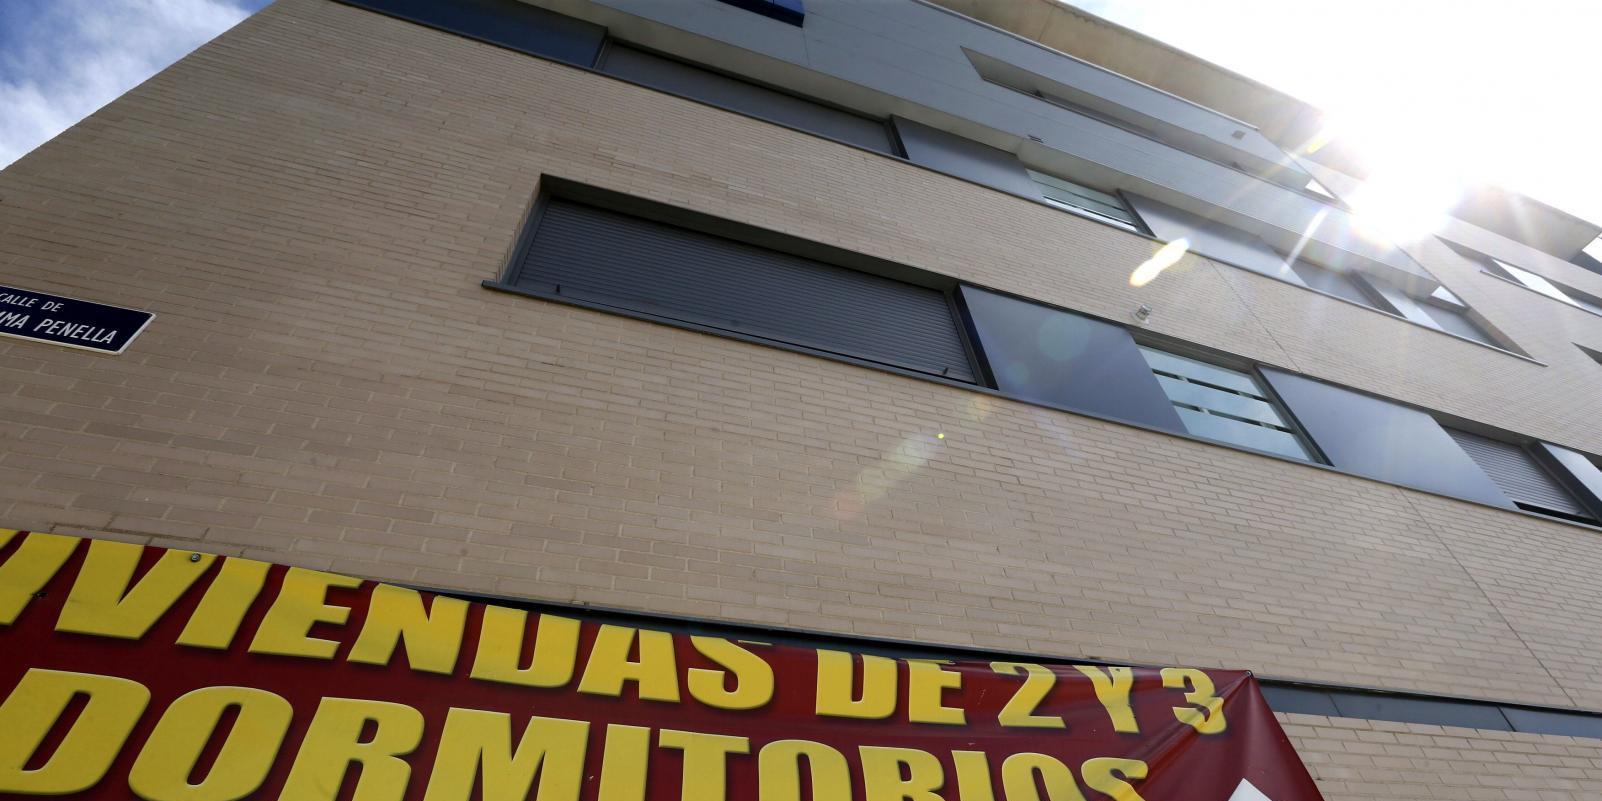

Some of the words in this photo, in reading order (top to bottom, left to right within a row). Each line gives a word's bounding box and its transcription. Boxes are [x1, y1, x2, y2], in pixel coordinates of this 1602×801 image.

[41, 301, 64, 312] DE
[0, 311, 30, 329] MA
[33, 318, 117, 343] PENELLA
[0, 528, 774, 710] IVIENDAS
[815, 649, 966, 725] DE
[990, 661, 1066, 729] 2
[1072, 664, 1140, 733] Y
[1162, 668, 1227, 735] 3
